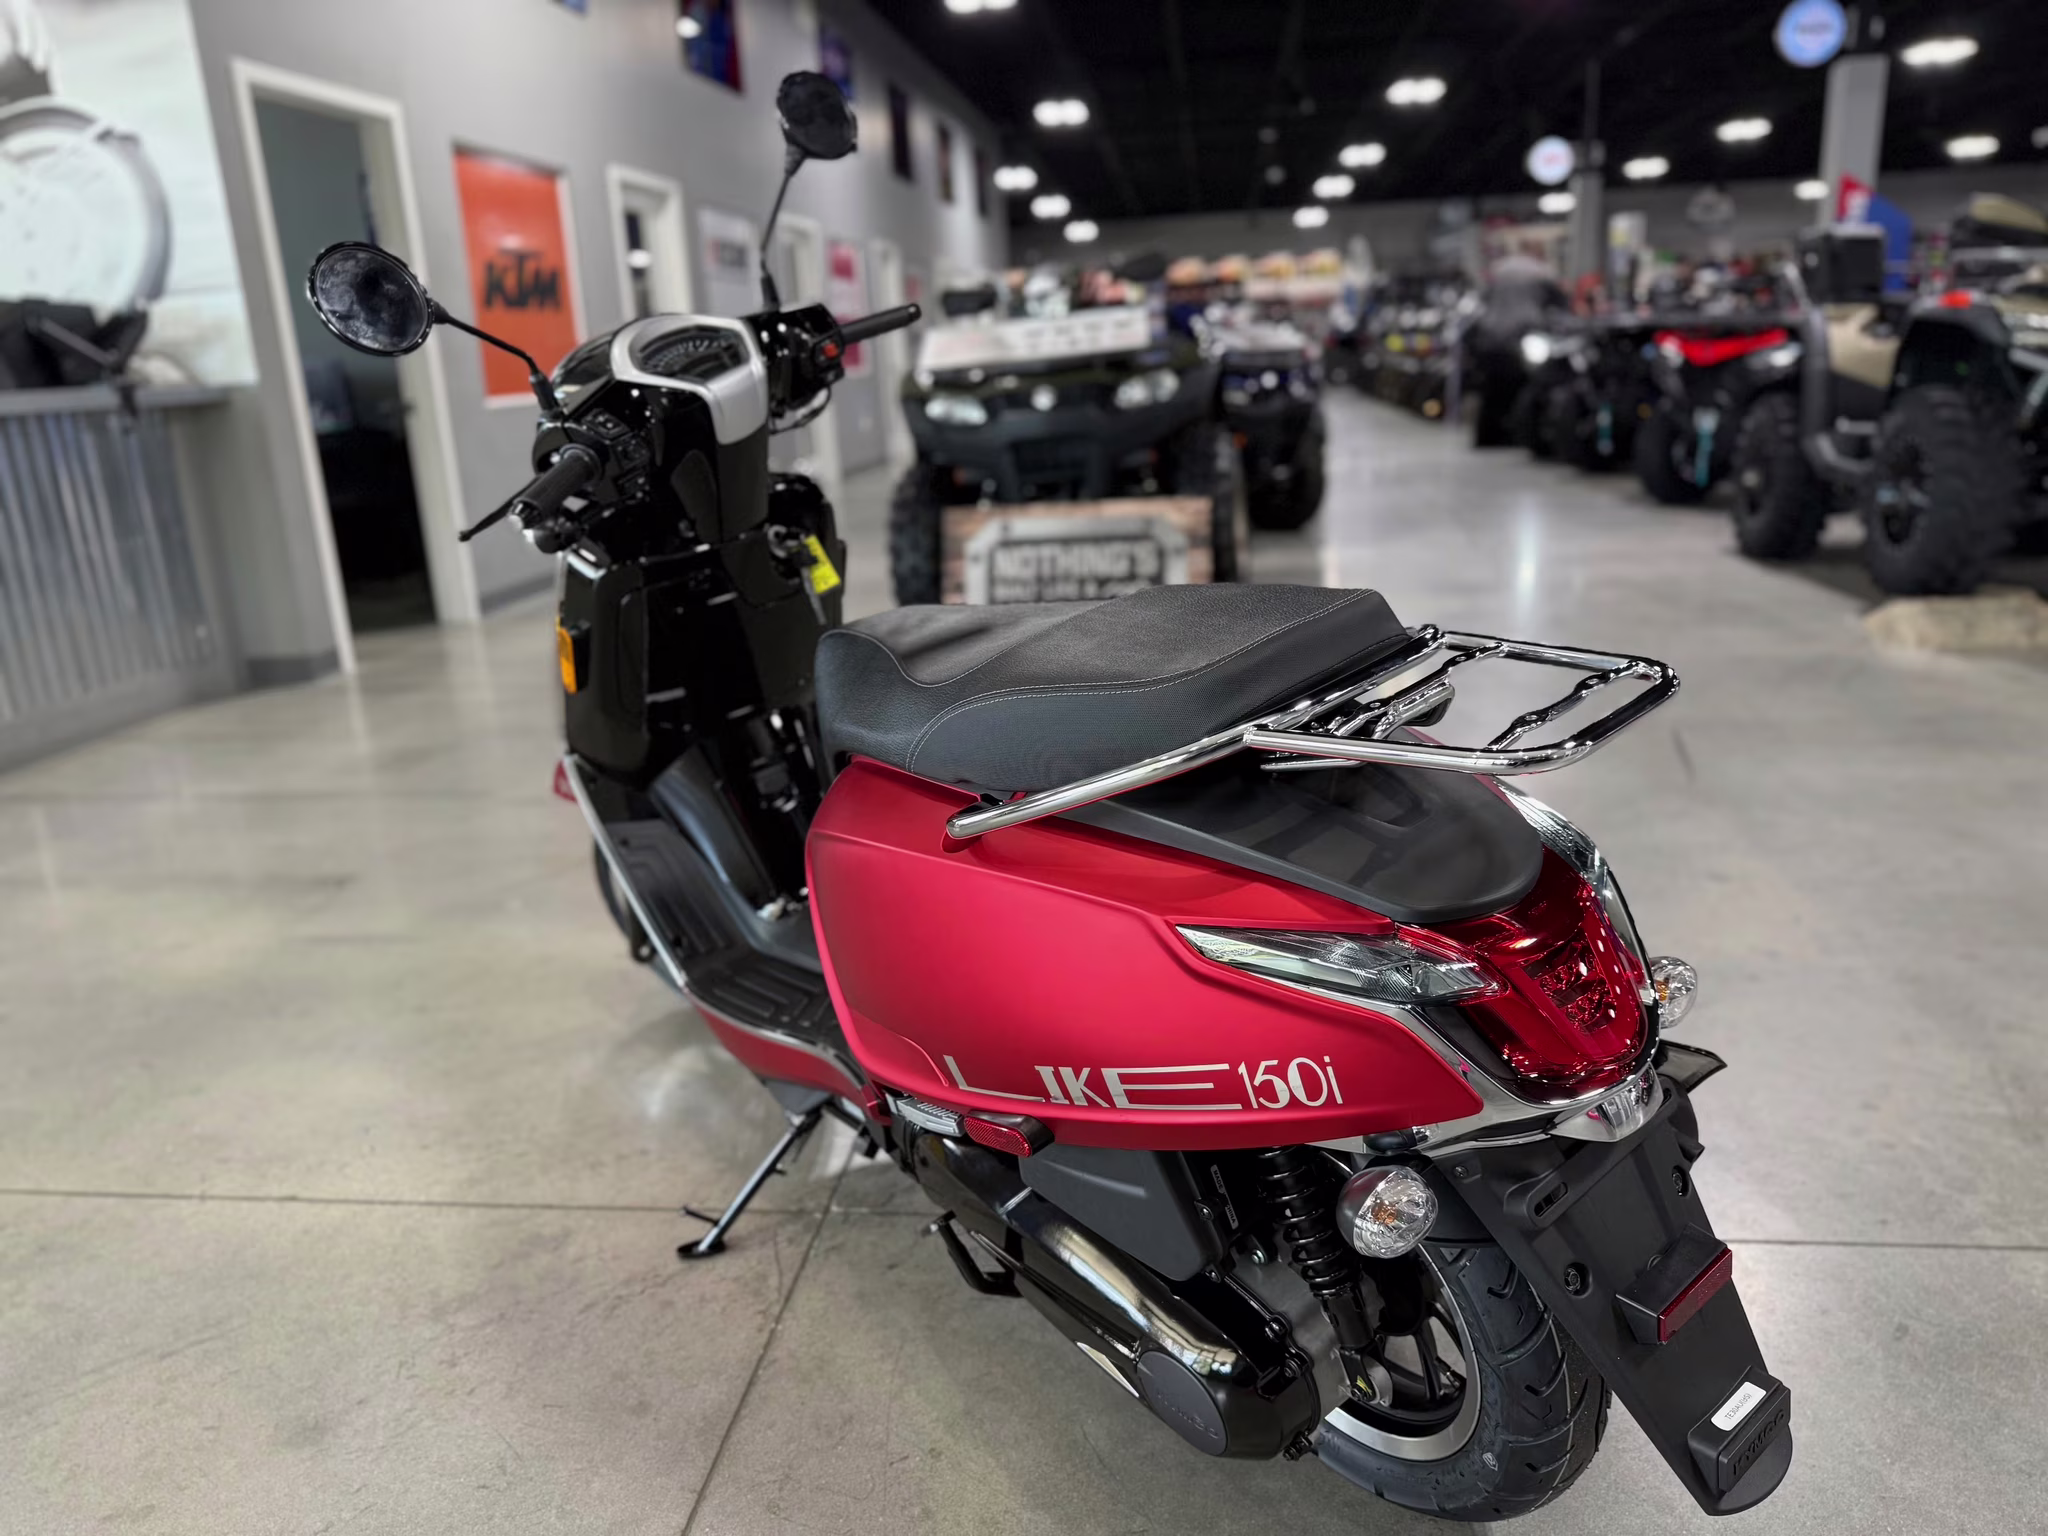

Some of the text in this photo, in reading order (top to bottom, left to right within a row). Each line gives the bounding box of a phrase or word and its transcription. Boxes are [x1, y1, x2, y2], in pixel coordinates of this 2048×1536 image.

[484, 249, 562, 310] KTM
[992, 542, 1160, 579] NOTHING'S
[943, 1055, 1344, 1110] LIKE 150i
[1213, 1169, 1225, 1190] MADE
